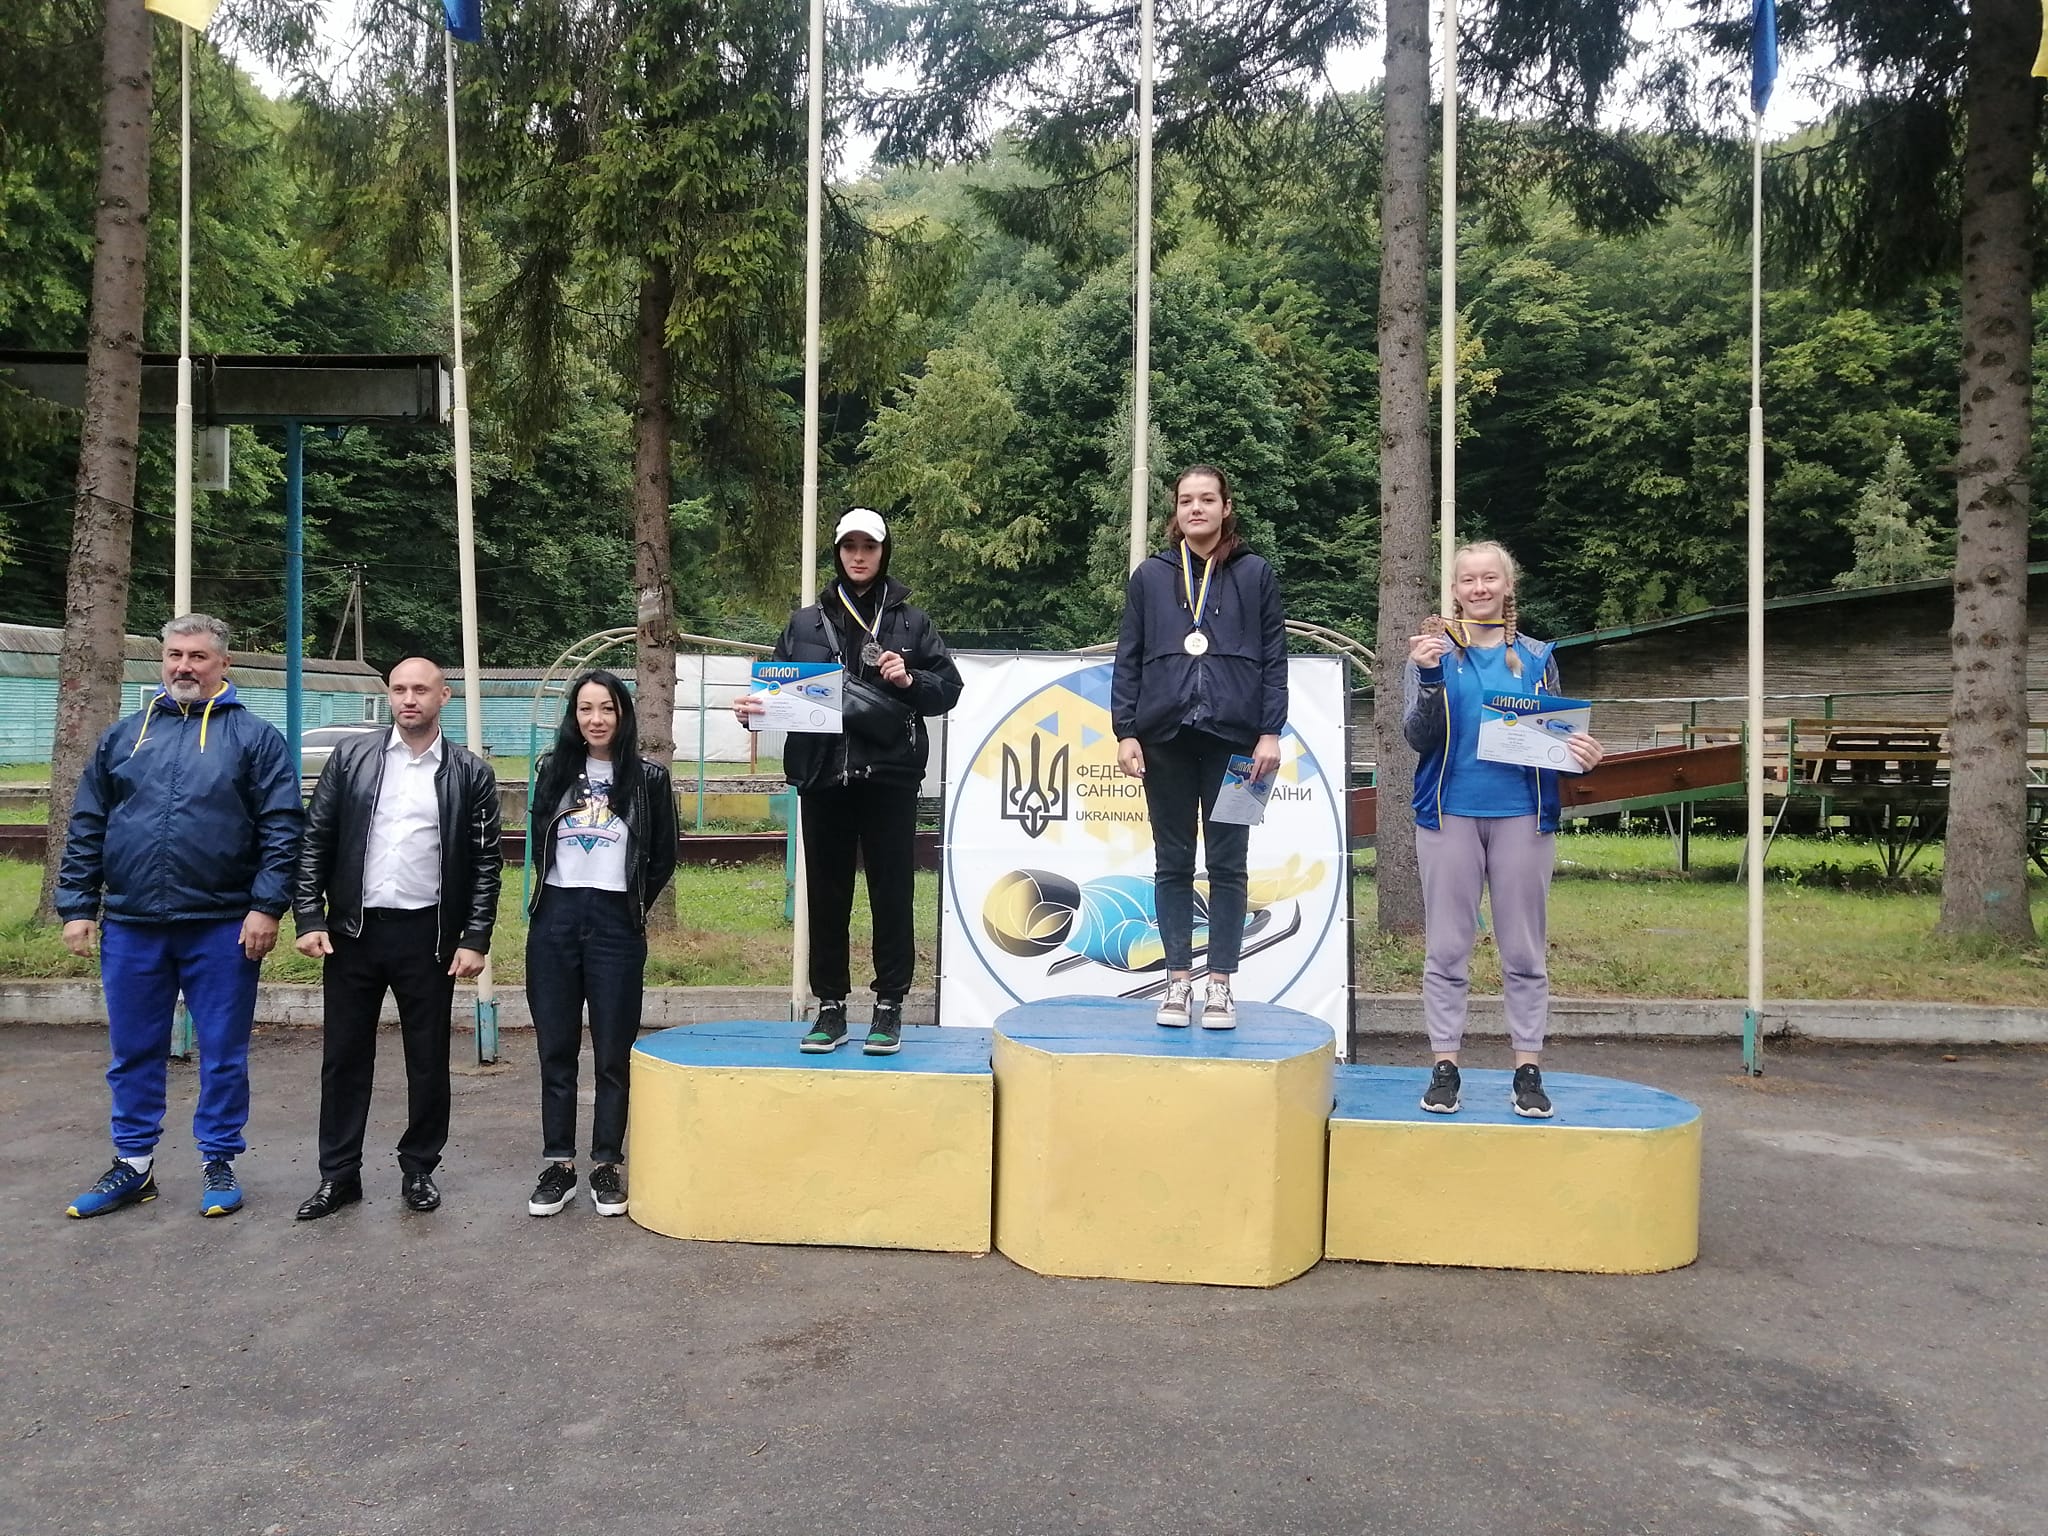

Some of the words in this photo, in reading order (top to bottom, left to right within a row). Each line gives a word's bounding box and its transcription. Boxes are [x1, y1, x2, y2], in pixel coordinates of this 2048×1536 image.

[758, 666, 800, 679] ДИПЛОМ
[1492, 695, 1541, 711] ДИПЛОМ
[1076, 764, 1127, 781] ФЕДЕ
[1076, 783, 1145, 798] САННОГ
[1270, 785, 1312, 801] АЇНИ
[1075, 811, 1144, 821] UKRAINIAN
